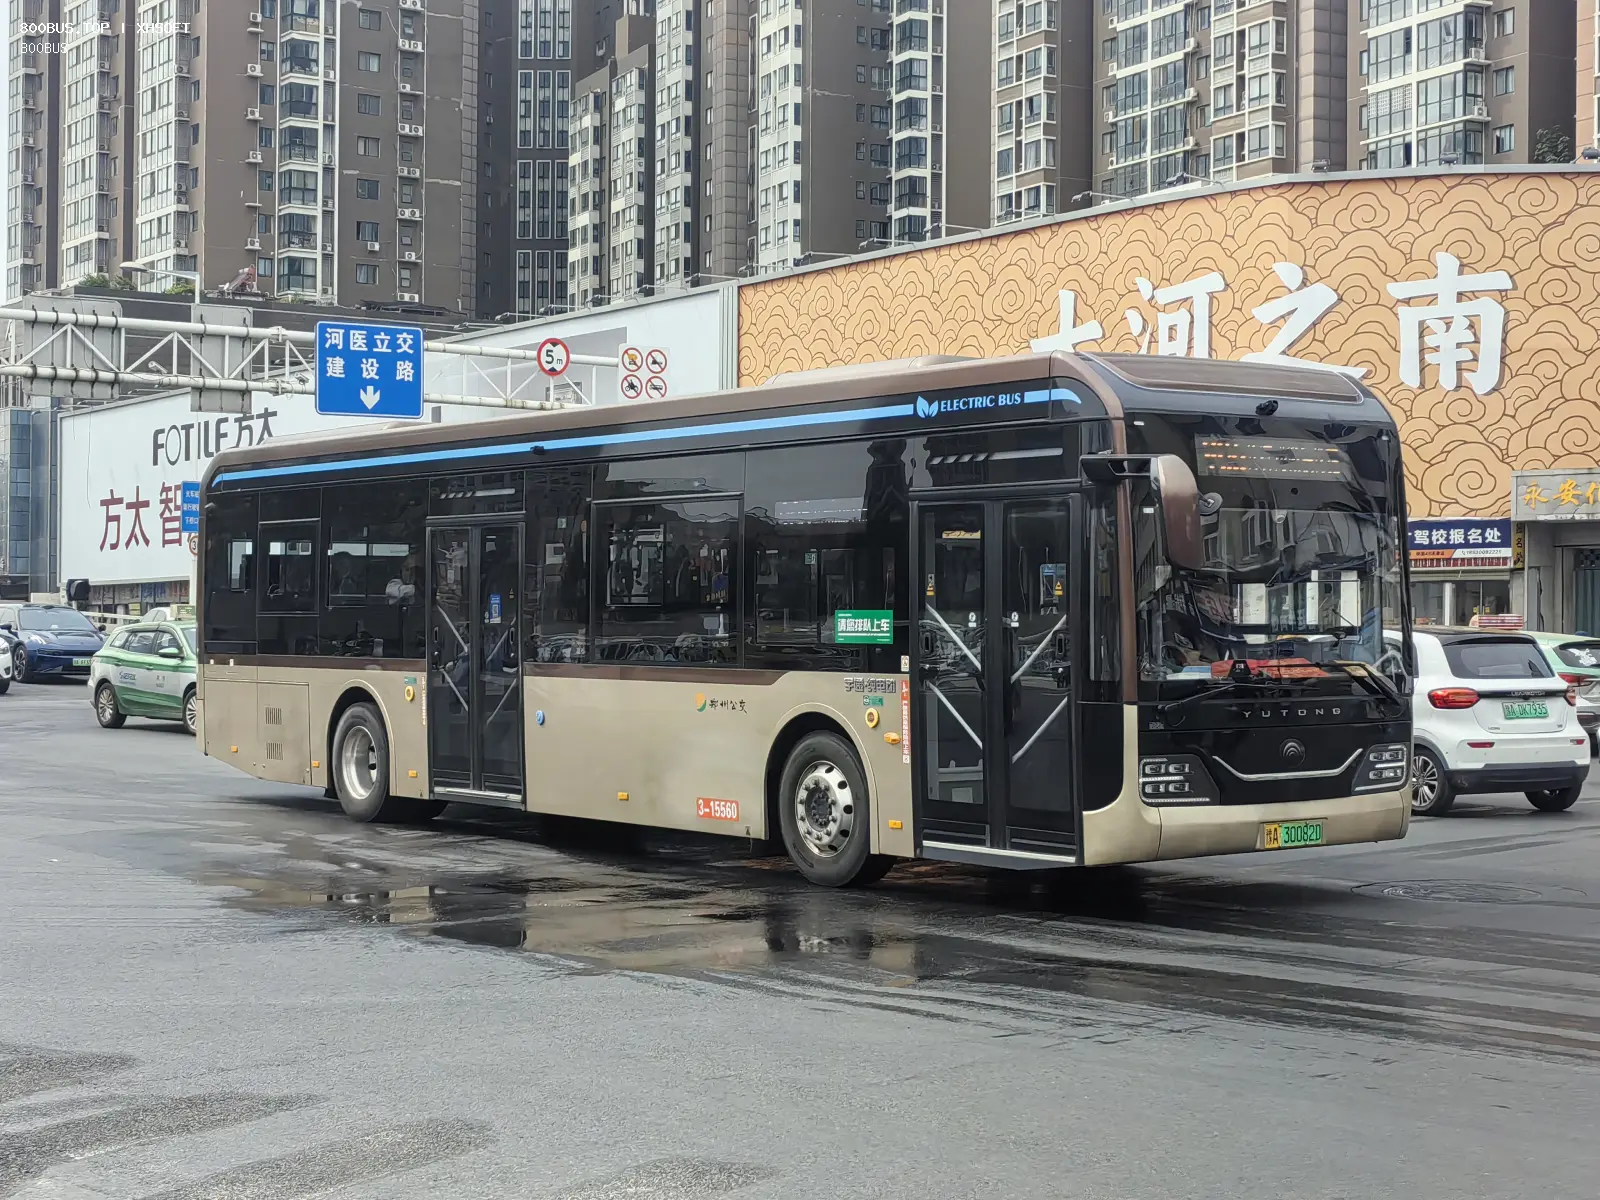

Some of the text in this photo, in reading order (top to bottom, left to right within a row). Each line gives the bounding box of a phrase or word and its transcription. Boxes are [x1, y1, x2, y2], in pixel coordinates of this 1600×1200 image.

[324, 326, 415, 354] 河医立交
[325, 356, 415, 382] 建设路
[940, 392, 1021, 412] ELECTRIC BUS
[152, 416, 229, 466] FOTILE
[1408, 527, 1502, 545] 驾校报名处
[709, 698, 748, 714] 郑州公交
[1242, 707, 1341, 718] YUTONG
[698, 799, 738, 819] 3-15560
